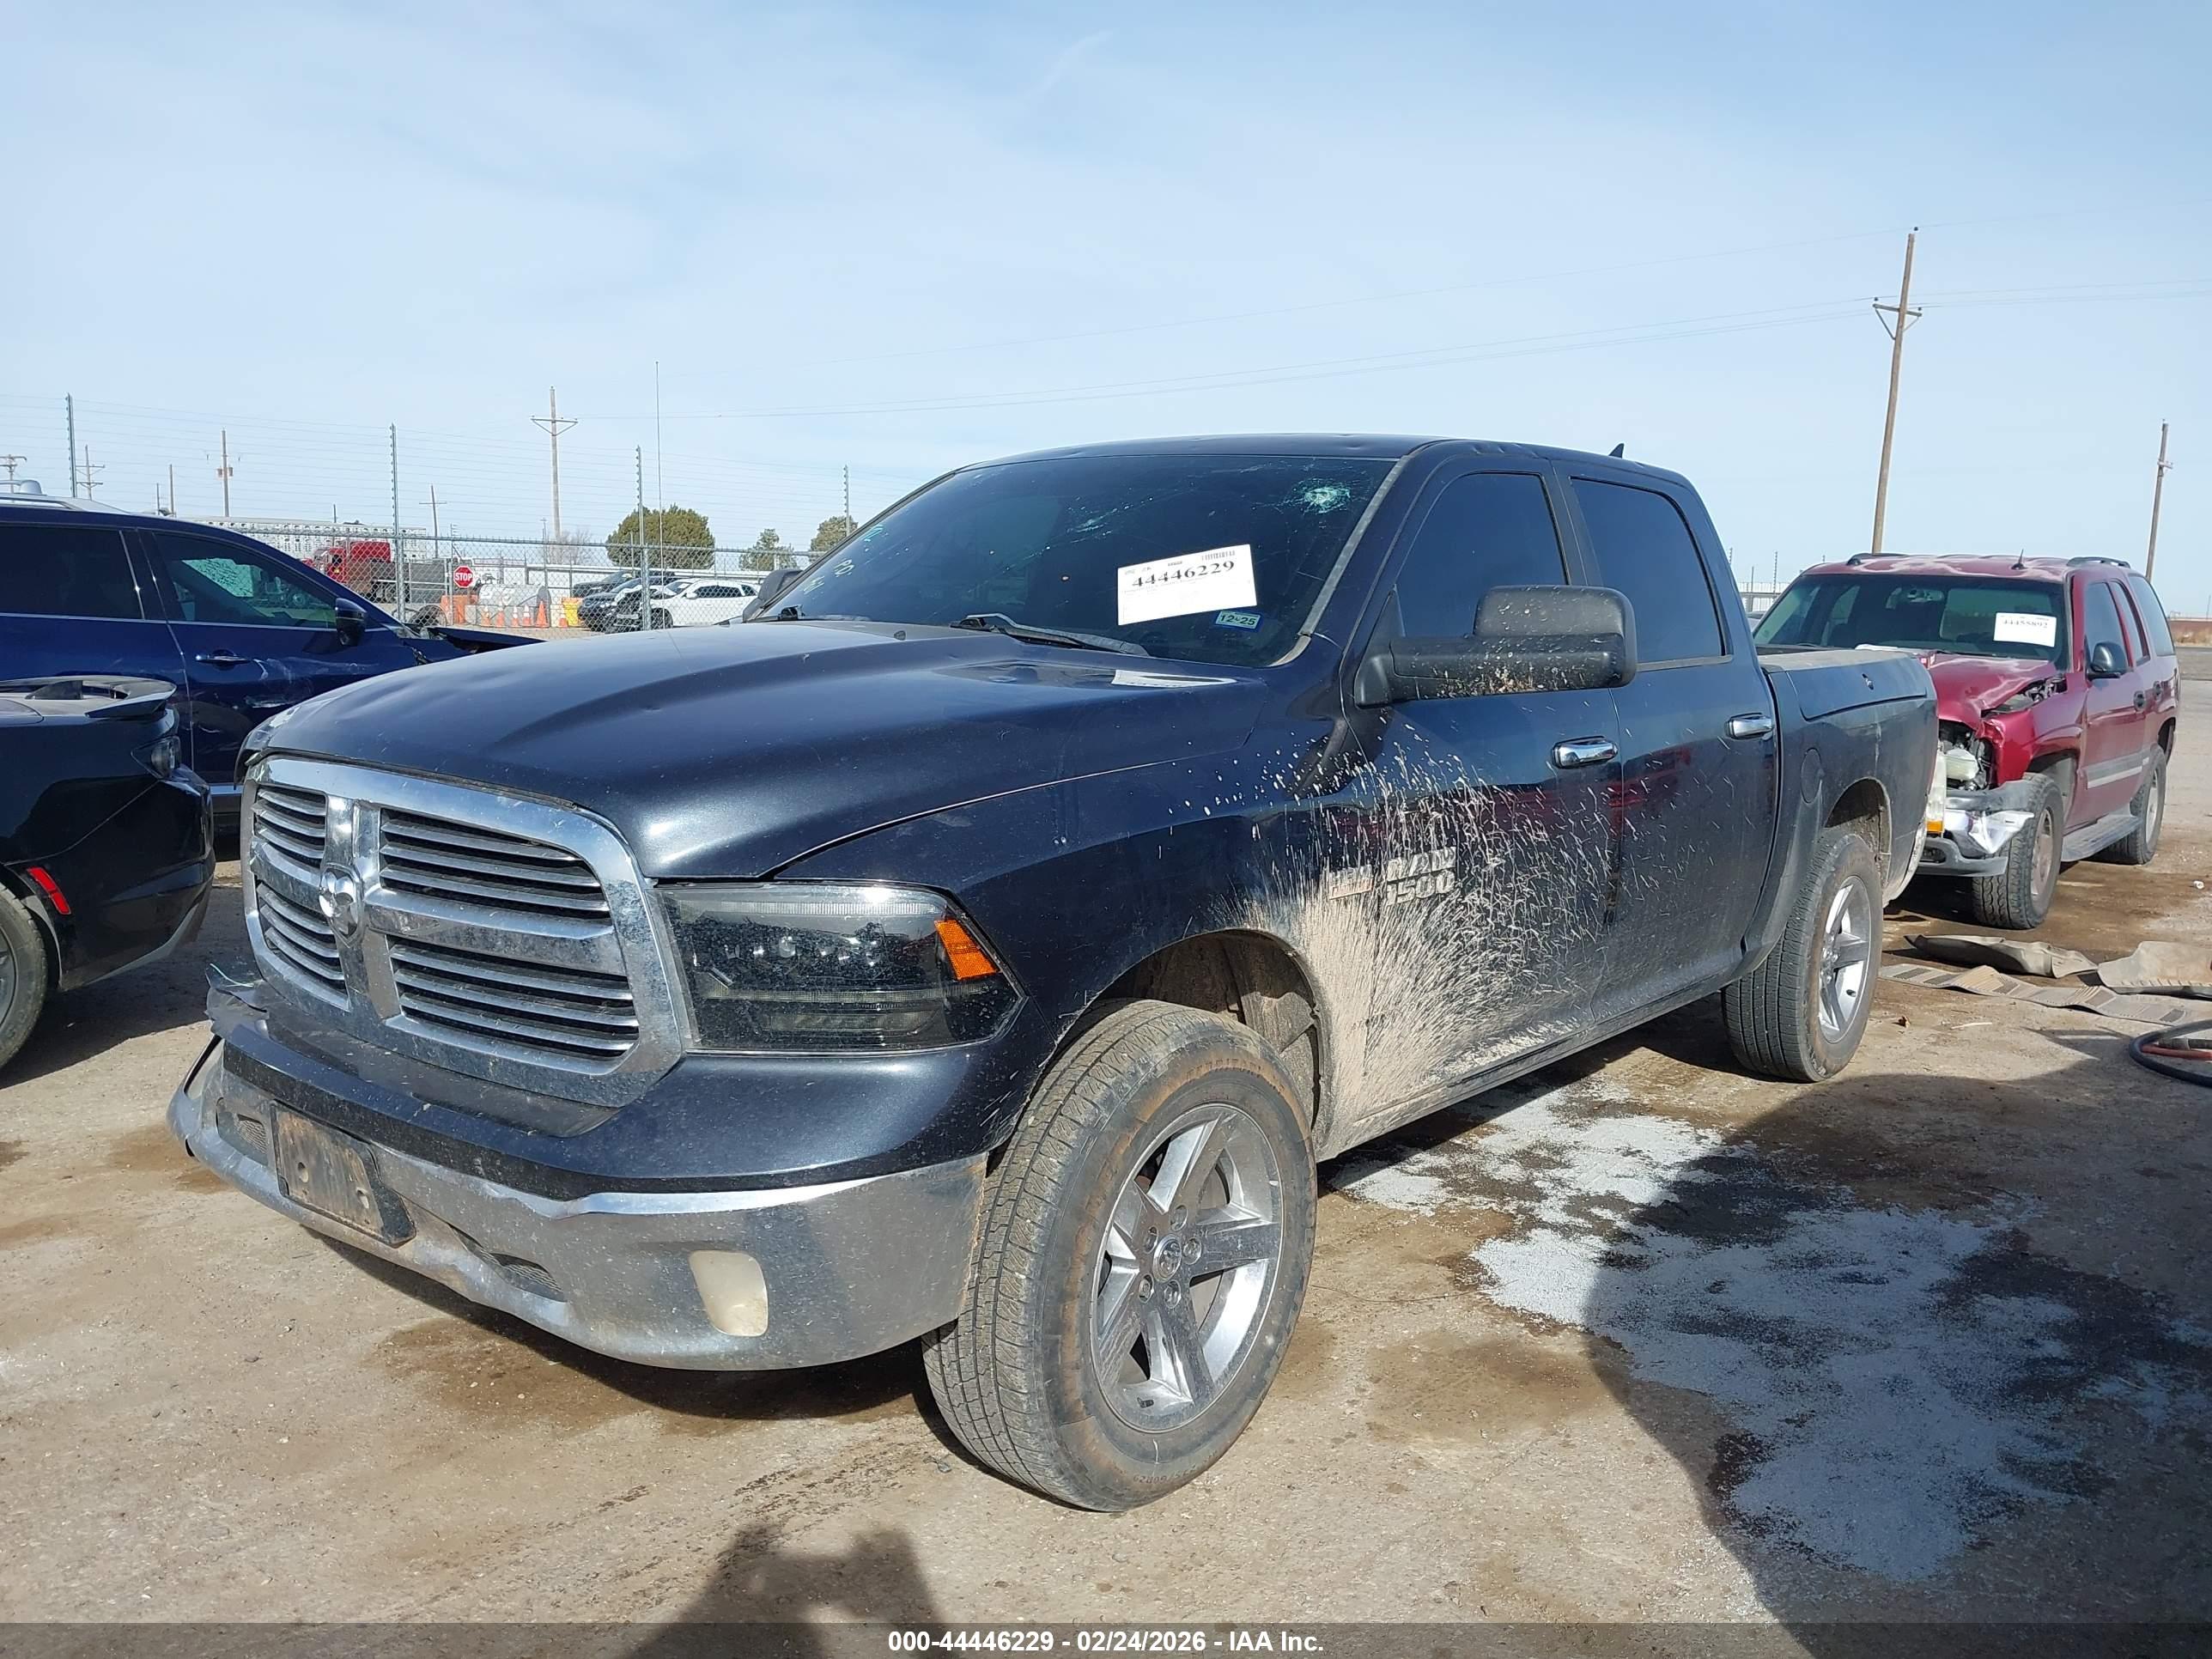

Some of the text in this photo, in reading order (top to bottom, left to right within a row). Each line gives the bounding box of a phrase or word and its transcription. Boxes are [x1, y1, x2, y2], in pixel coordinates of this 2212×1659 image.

[455, 573, 472, 581] STOP
[1132, 561, 1235, 586] 44446229
[1387, 870, 1455, 906] 1500
